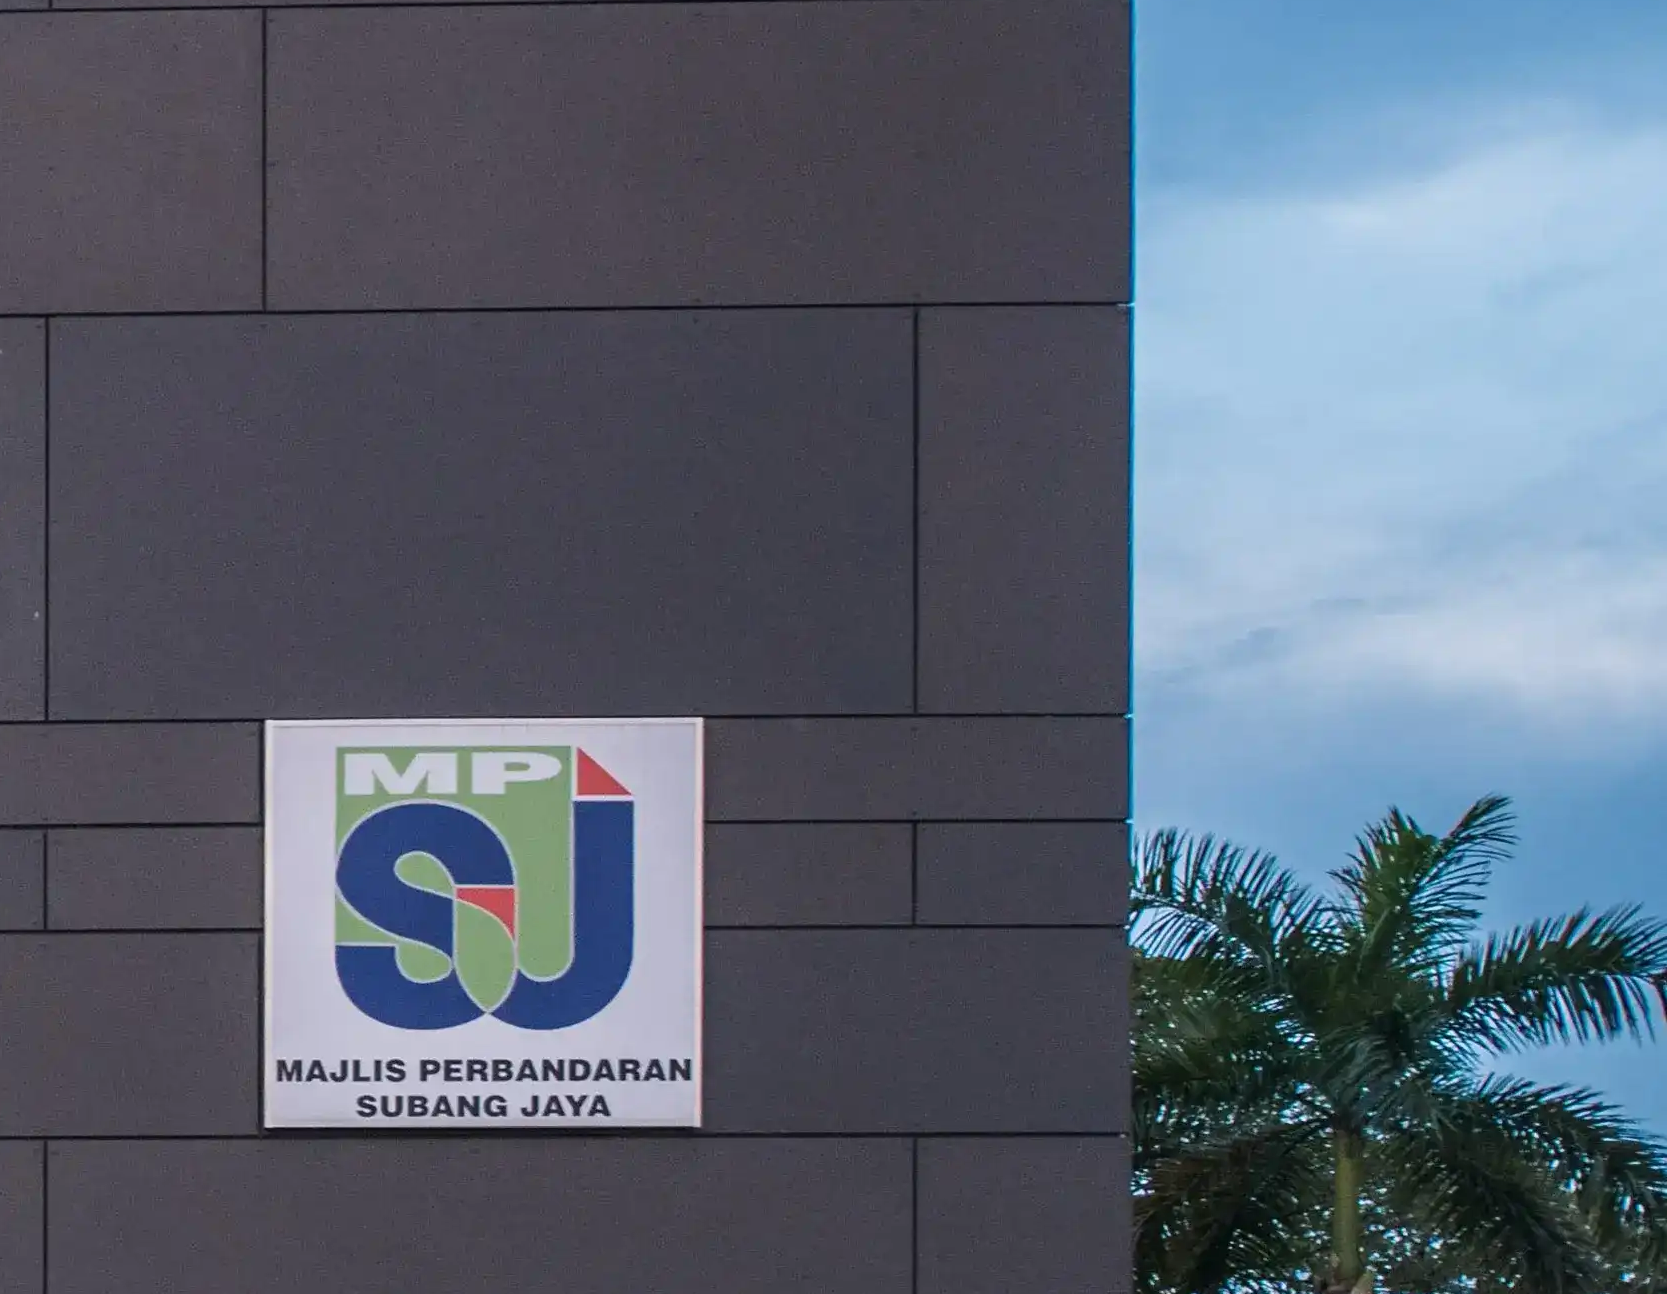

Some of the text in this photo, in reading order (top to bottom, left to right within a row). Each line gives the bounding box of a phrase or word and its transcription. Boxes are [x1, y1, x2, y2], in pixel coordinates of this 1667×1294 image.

[343, 752, 563, 796] MP
[275, 1058, 693, 1083] MAJLIS PERBANDARAN
[355, 1093, 612, 1118] SUBANG JAYA
